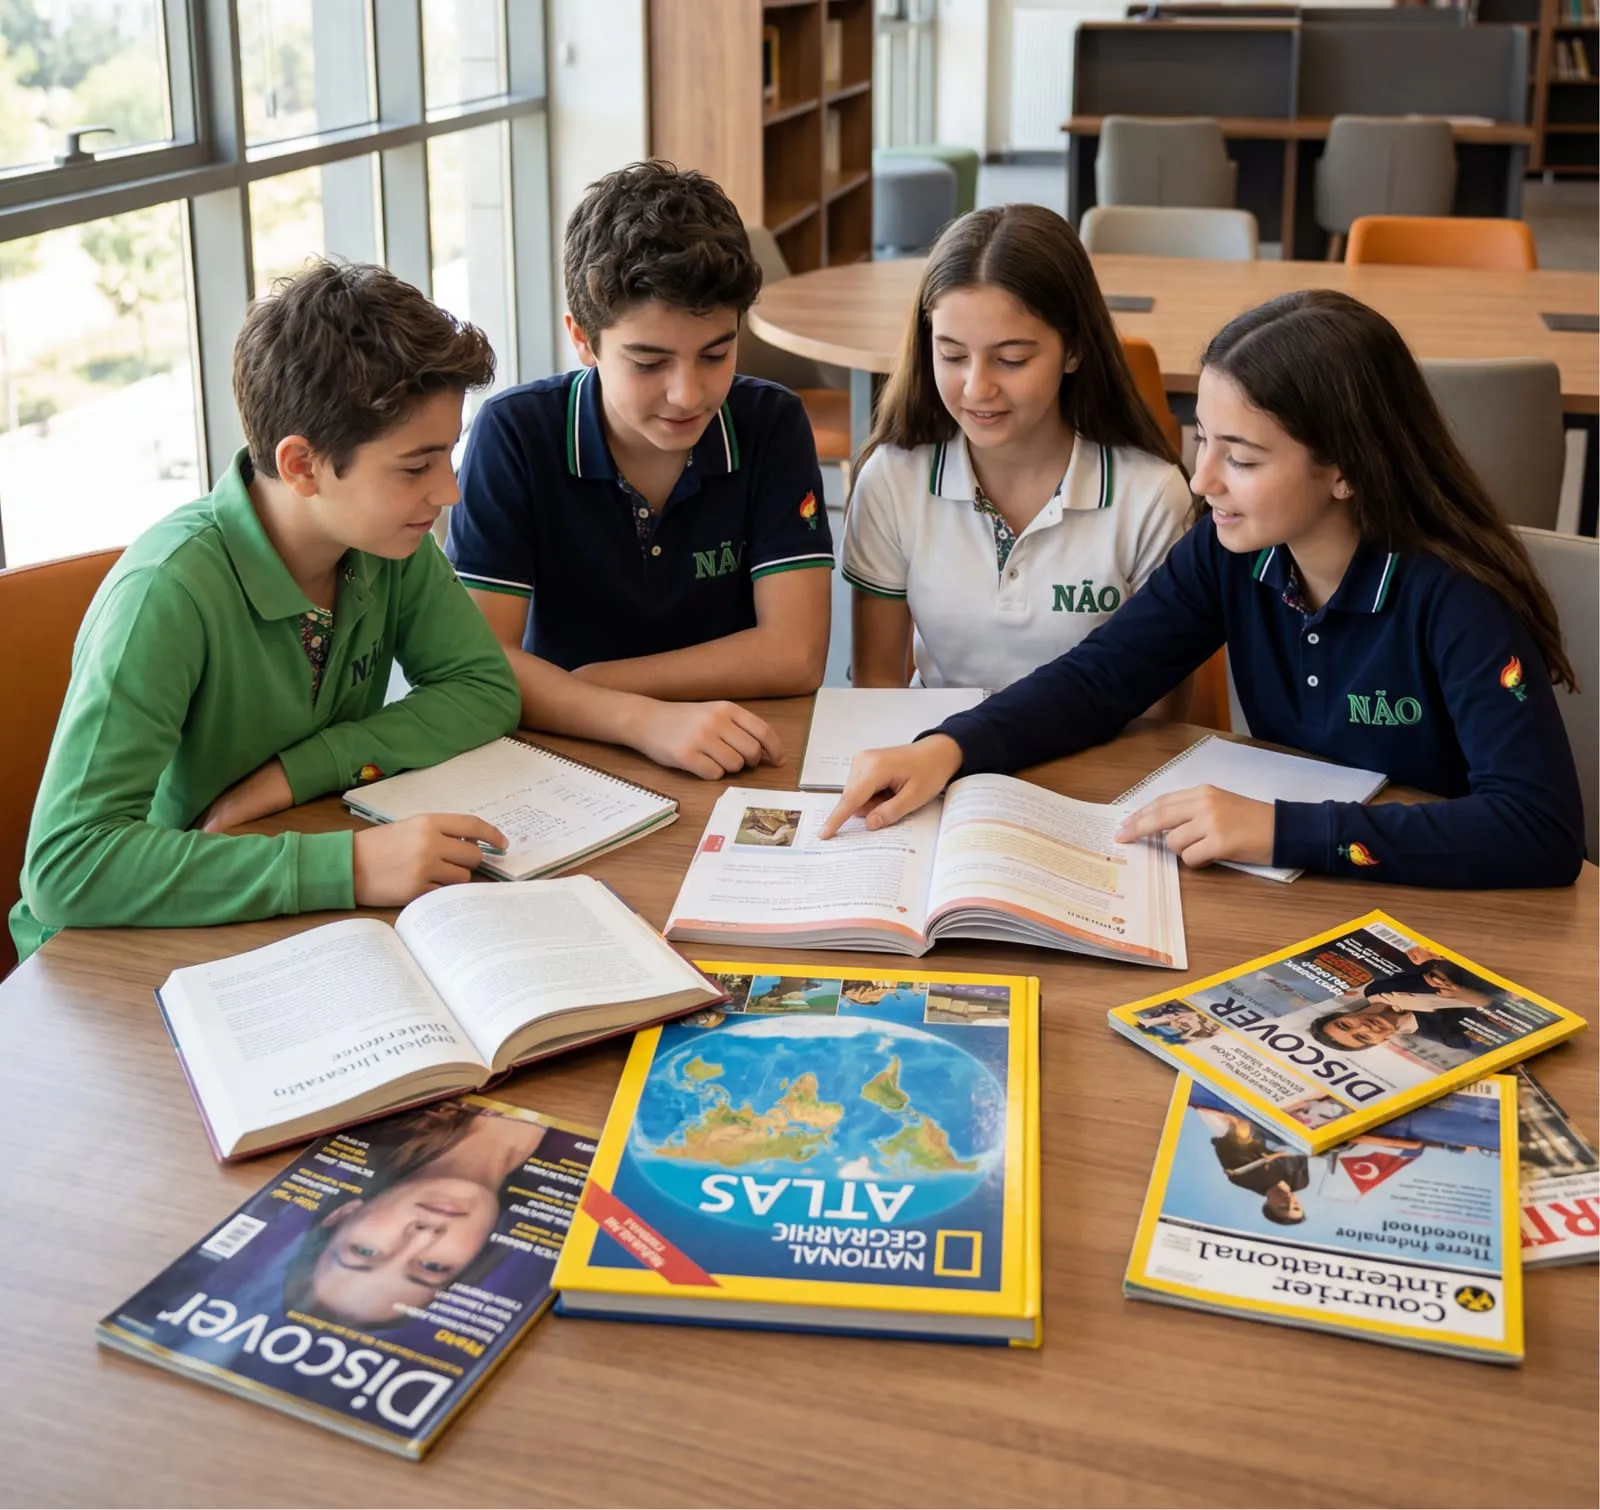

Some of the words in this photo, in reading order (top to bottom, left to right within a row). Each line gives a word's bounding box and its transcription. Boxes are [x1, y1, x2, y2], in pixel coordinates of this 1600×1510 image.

[692, 541, 748, 579] NÃ
[1051, 579, 1121, 613] NÃO
[1346, 689, 1422, 725] NÃO
[1209, 997, 1387, 1104] DISCOVER
[699, 1173, 916, 1223] ATLAS
[788, 1245, 925, 1271] NATIONAL
[1271, 1276, 1447, 1323] Courrier
[155, 1292, 455, 1430] Discover
